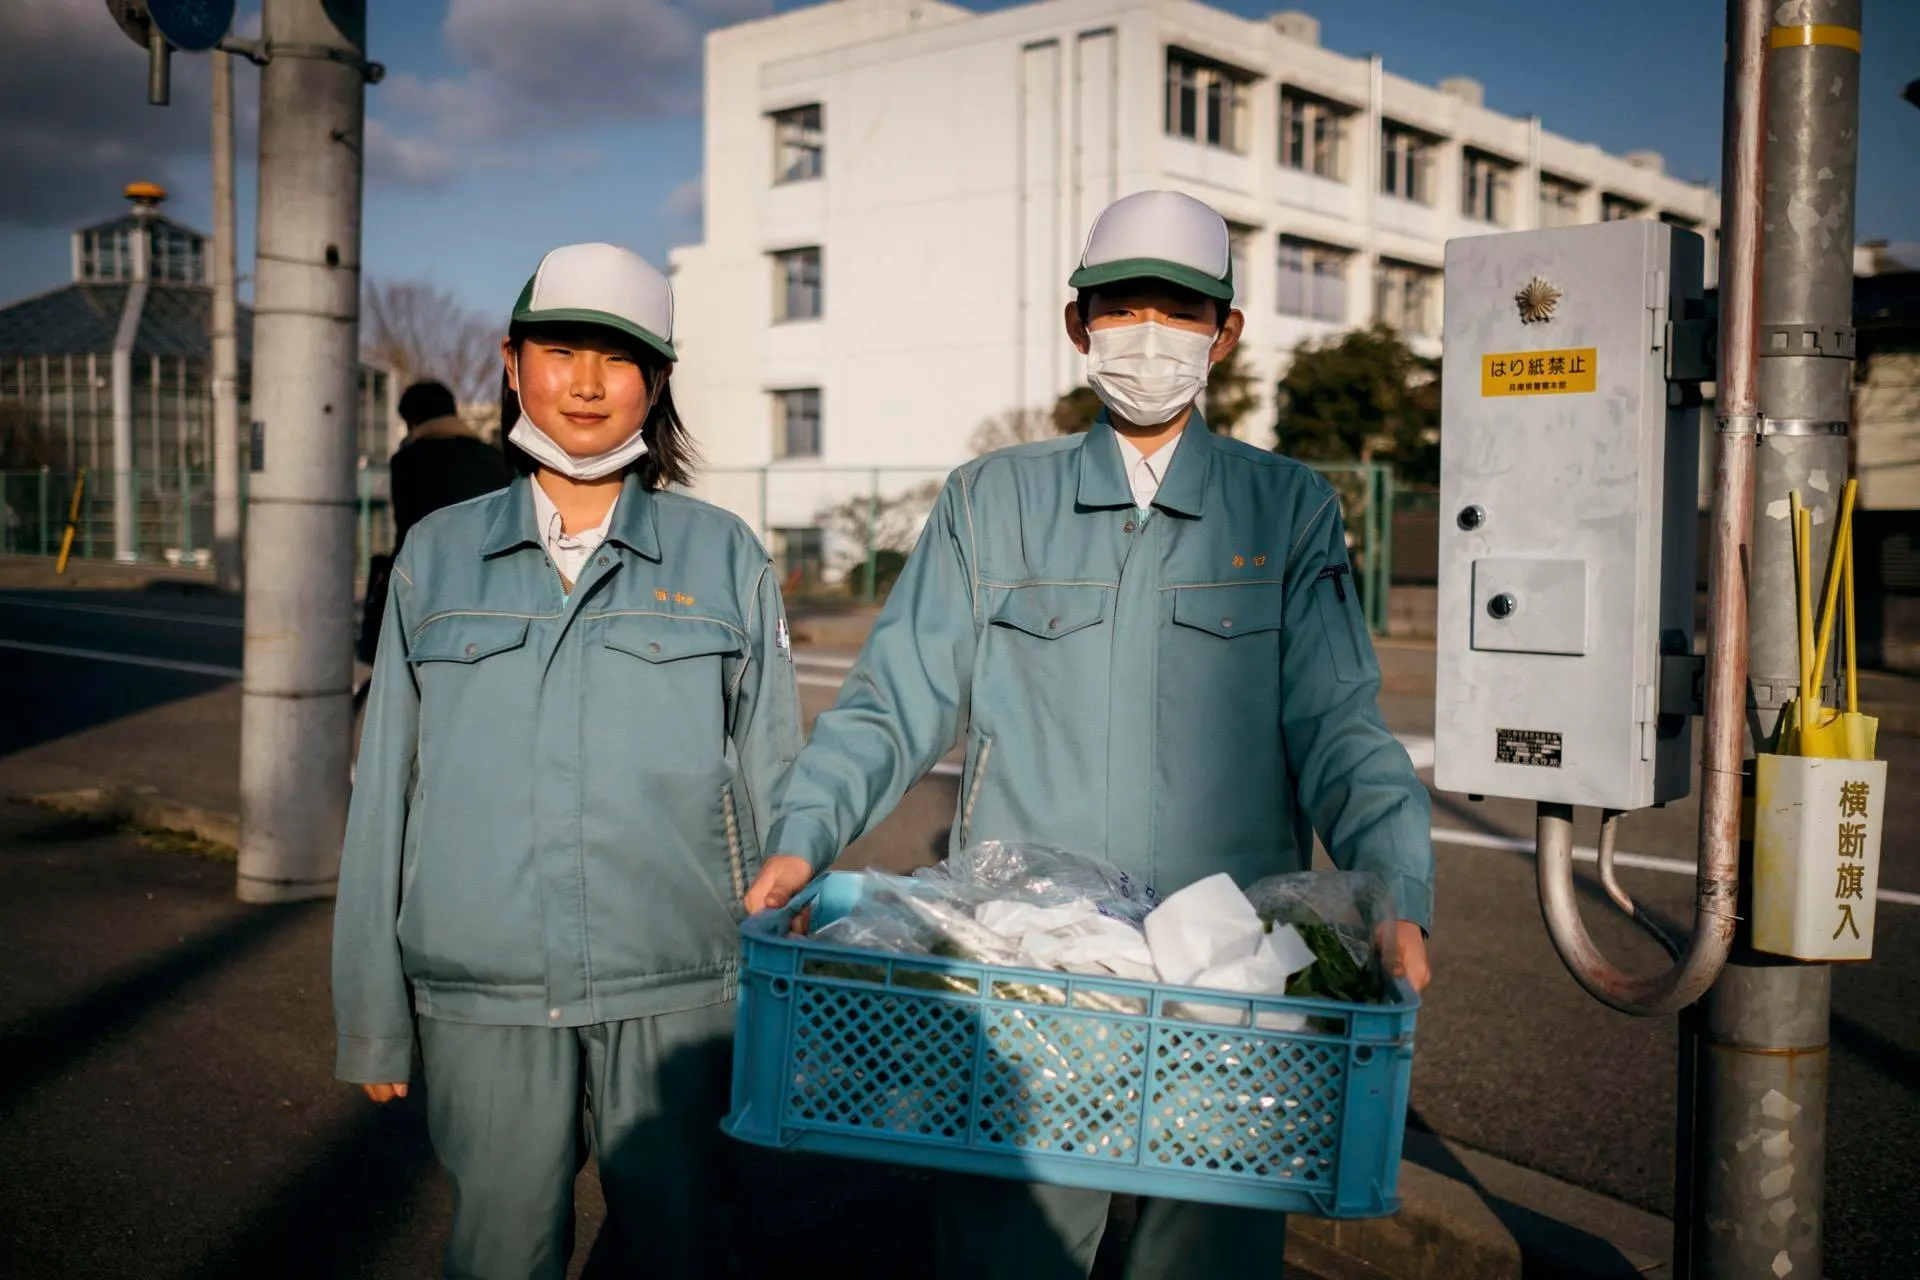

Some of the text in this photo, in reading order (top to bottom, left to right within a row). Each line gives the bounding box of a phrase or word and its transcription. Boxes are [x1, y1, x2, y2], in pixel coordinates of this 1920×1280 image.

[1491, 356, 1586, 377] はり紙禁止
[1832, 780, 1870, 940] 横断旗入
